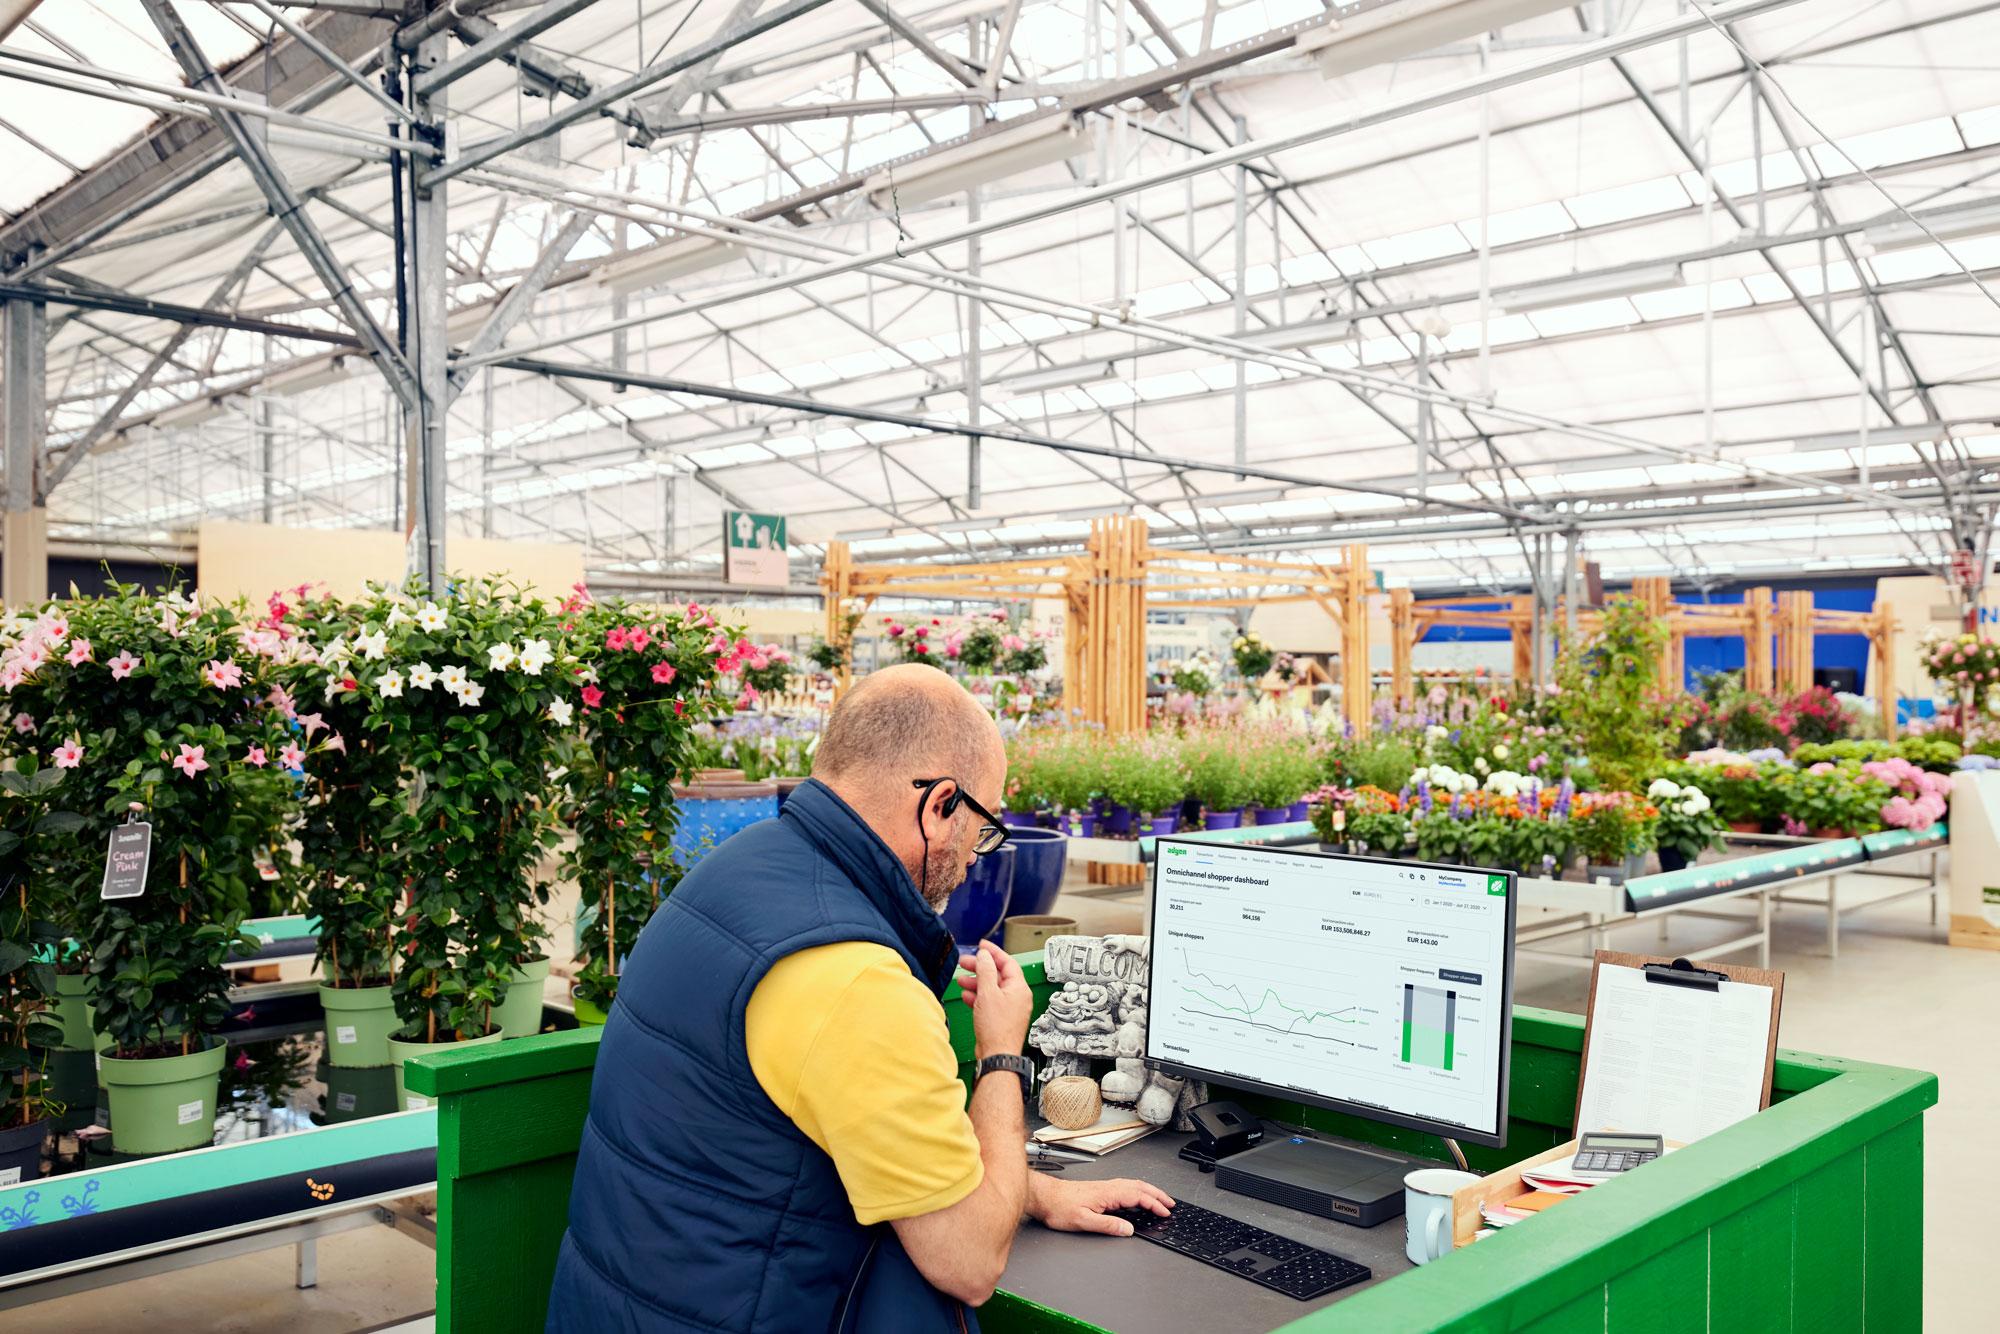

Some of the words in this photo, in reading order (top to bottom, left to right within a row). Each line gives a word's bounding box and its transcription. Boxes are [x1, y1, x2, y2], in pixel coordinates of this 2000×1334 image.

[112, 850, 144, 861] Cream
[115, 861, 139, 873] Pink
[1166, 867, 1207, 879] Omnichannel
[1207, 871, 1234, 883] shopper
[1234, 875, 1269, 886] dashboard
[1321, 924, 1333, 932] EUR
[1168, 929, 1184, 938] Unique
[1184, 931, 1204, 940] shoppers
[1407, 936, 1419, 944] EUR
[1420, 938, 1438, 946] 143.00
[1048, 942, 1149, 983] WELCOM
[1163, 1042, 1190, 1054] Transactions
[1334, 1202, 1358, 1214] Lenovo
